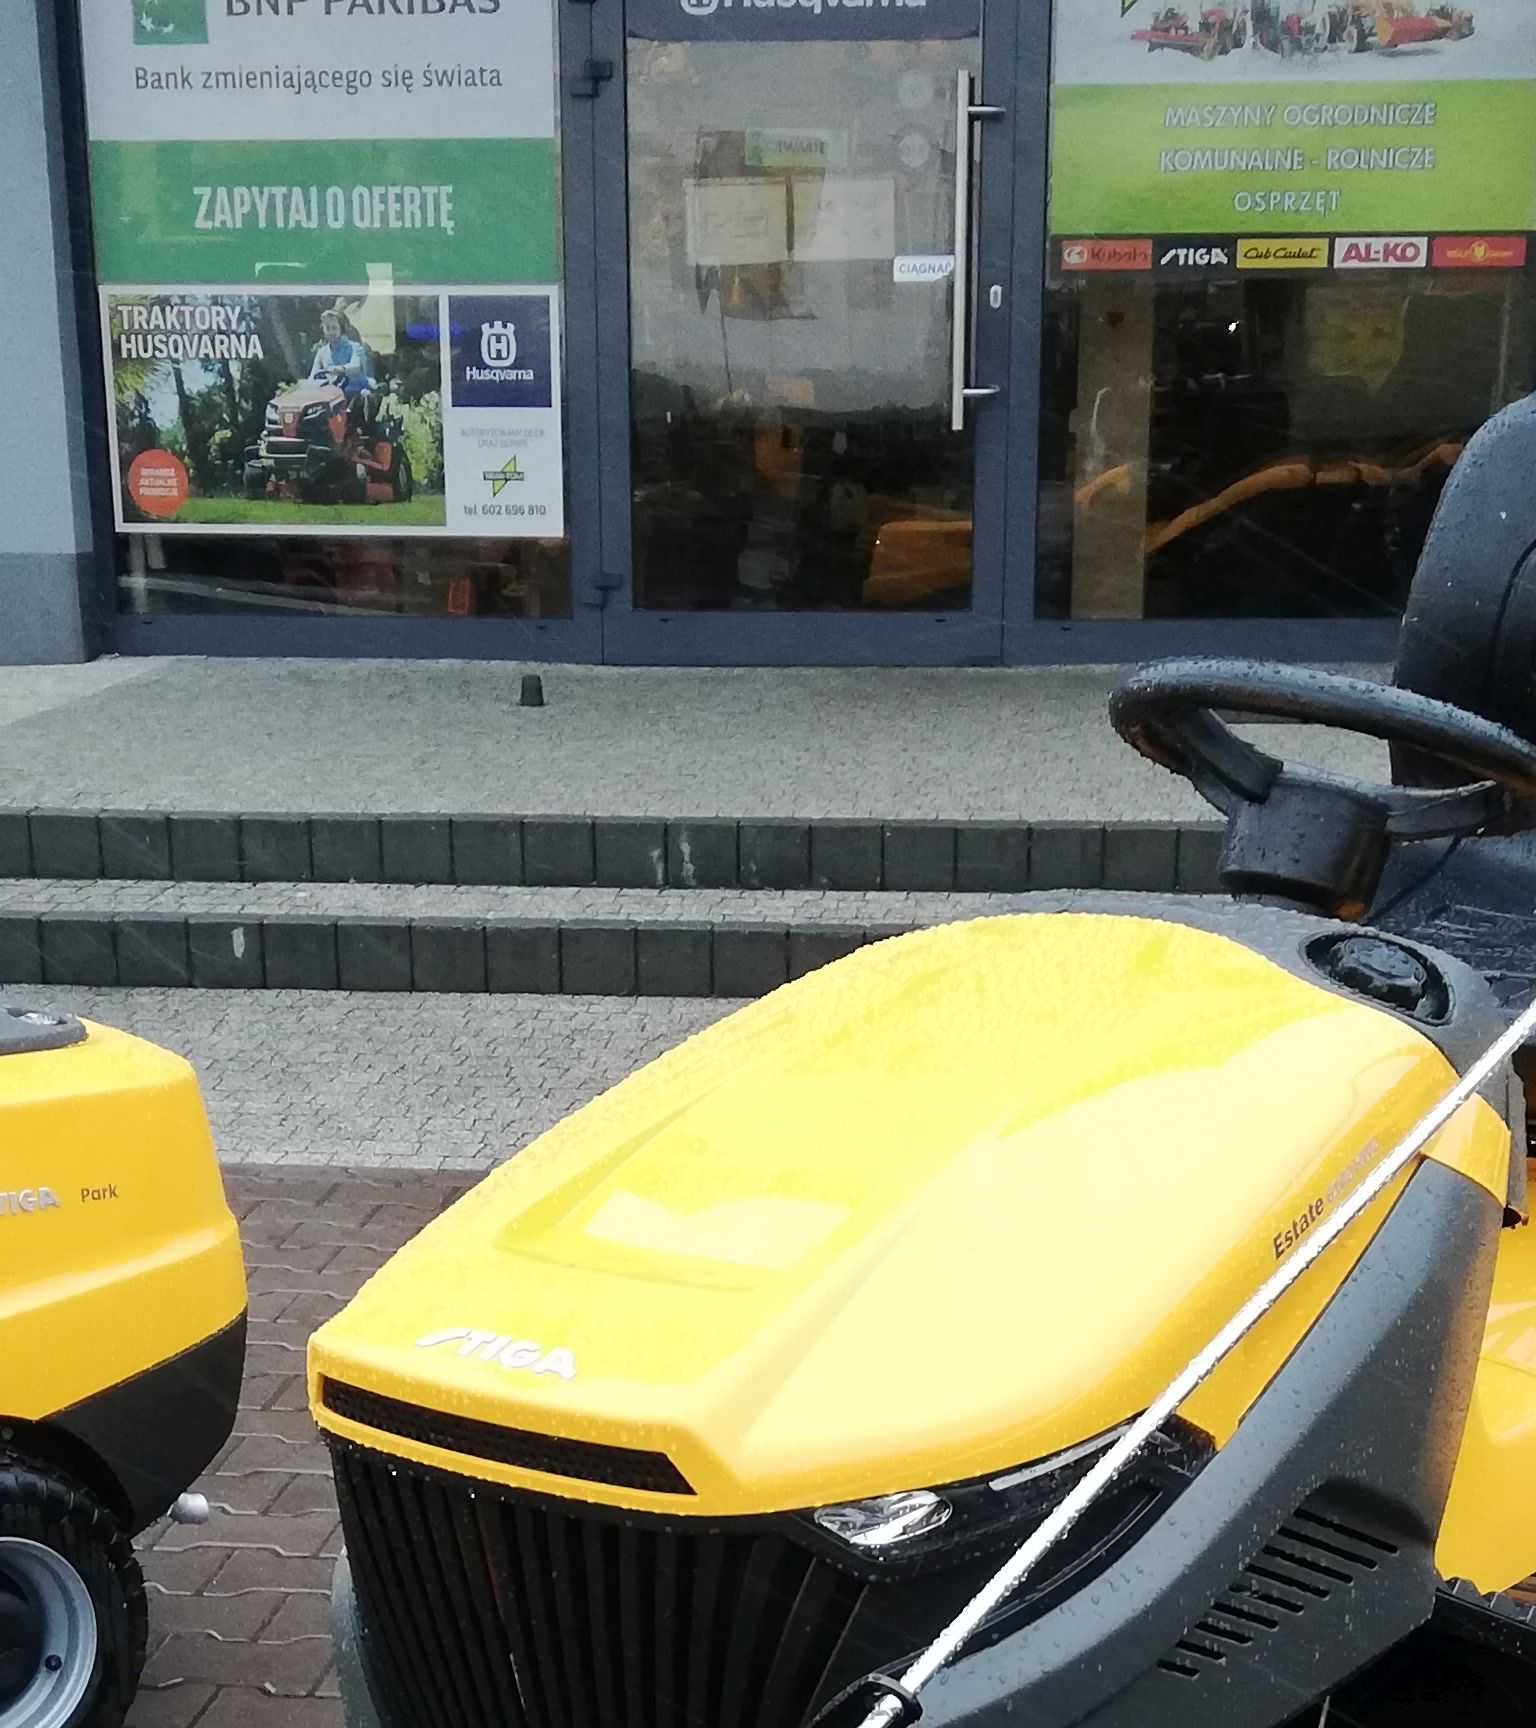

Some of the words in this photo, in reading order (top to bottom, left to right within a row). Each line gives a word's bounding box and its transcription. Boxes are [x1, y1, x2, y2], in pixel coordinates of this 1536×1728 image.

[226, 0, 305, 16] BNP
[324, 0, 501, 15] PARIBAS
[135, 66, 193, 90] Bank
[202, 64, 372, 95] zmieniającego
[381, 63, 414, 93] się
[423, 62, 503, 88] świata
[1165, 104, 1276, 127] MASZYNY
[1284, 103, 1436, 126] OGRODNICZE
[1160, 149, 1304, 171] KOMUNALNE
[1327, 148, 1435, 170] ROLNICZE
[193, 185, 318, 229] ZAPYTAJ
[326, 186, 345, 229] O
[352, 185, 454, 235] OFERTĘ
[1233, 190, 1341, 216] OSPRZĘT
[1161, 247, 1229, 265] STIGA
[1244, 247, 1272, 259] Cub
[1342, 242, 1421, 263] AL-KO
[117, 305, 241, 330] TRAKTORY
[120, 334, 264, 360] HUSQVARNA
[466, 366, 534, 382] Husqvarna
[81, 1184, 120, 1203] Park
[1272, 1197, 1325, 1261] Estate
[416, 1328, 577, 1381] STIGA
